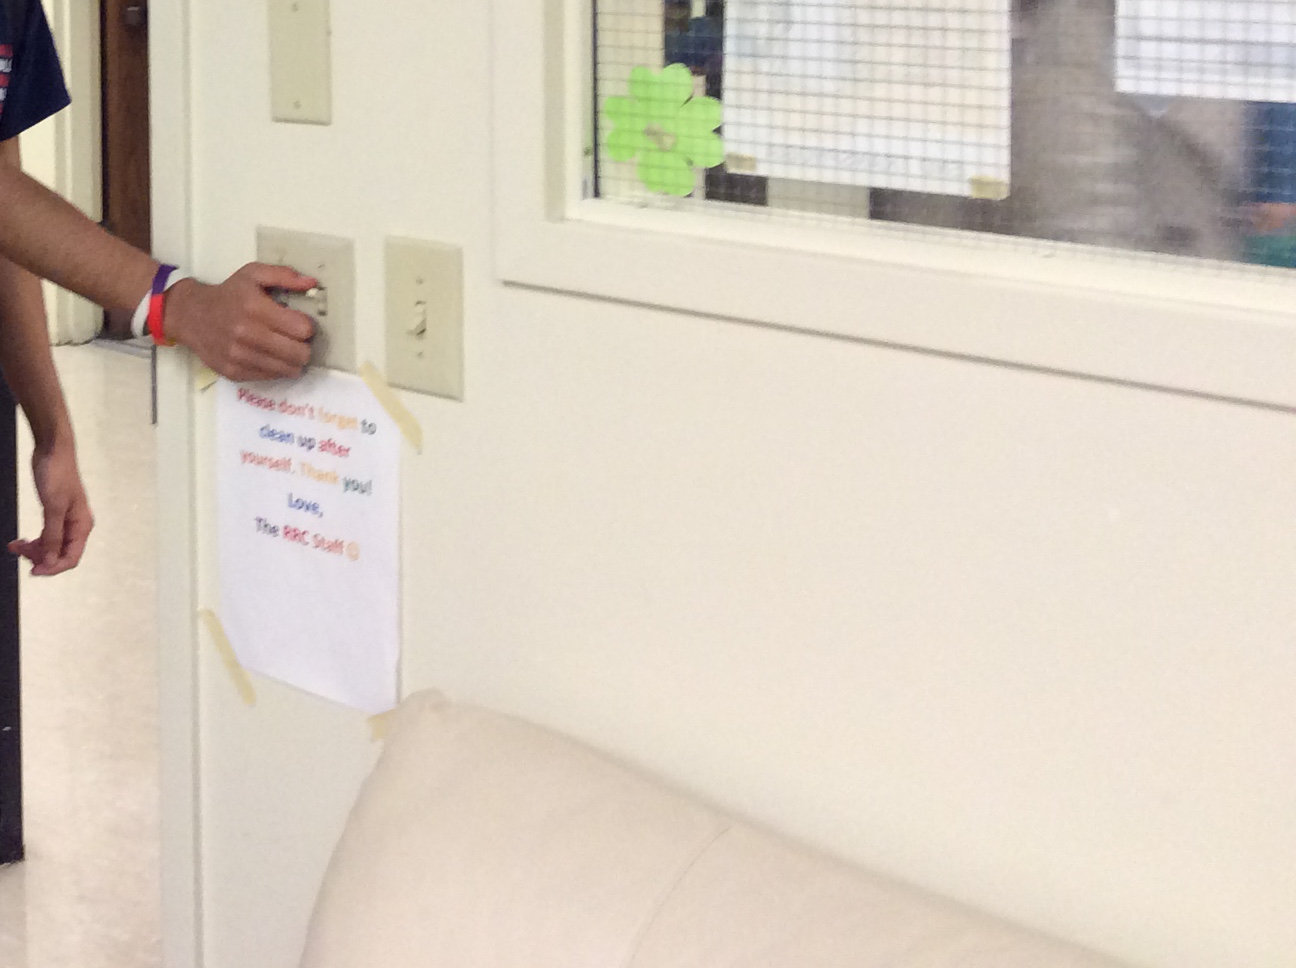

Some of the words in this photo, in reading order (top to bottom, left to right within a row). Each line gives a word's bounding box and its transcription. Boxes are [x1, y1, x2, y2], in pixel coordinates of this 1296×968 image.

[237, 387, 276, 411] Please
[278, 399, 315, 420] don't
[318, 406, 359, 430] forget
[361, 419, 378, 435] to
[297, 435, 317, 451] up
[319, 438, 352, 457] after
[300, 462, 340, 484] Thank
[342, 477, 374, 496] you!
[288, 493, 324, 517] Love,
[255, 517, 280, 536] The
[282, 525, 310, 546] RRC
[312, 534, 345, 555] Staff
